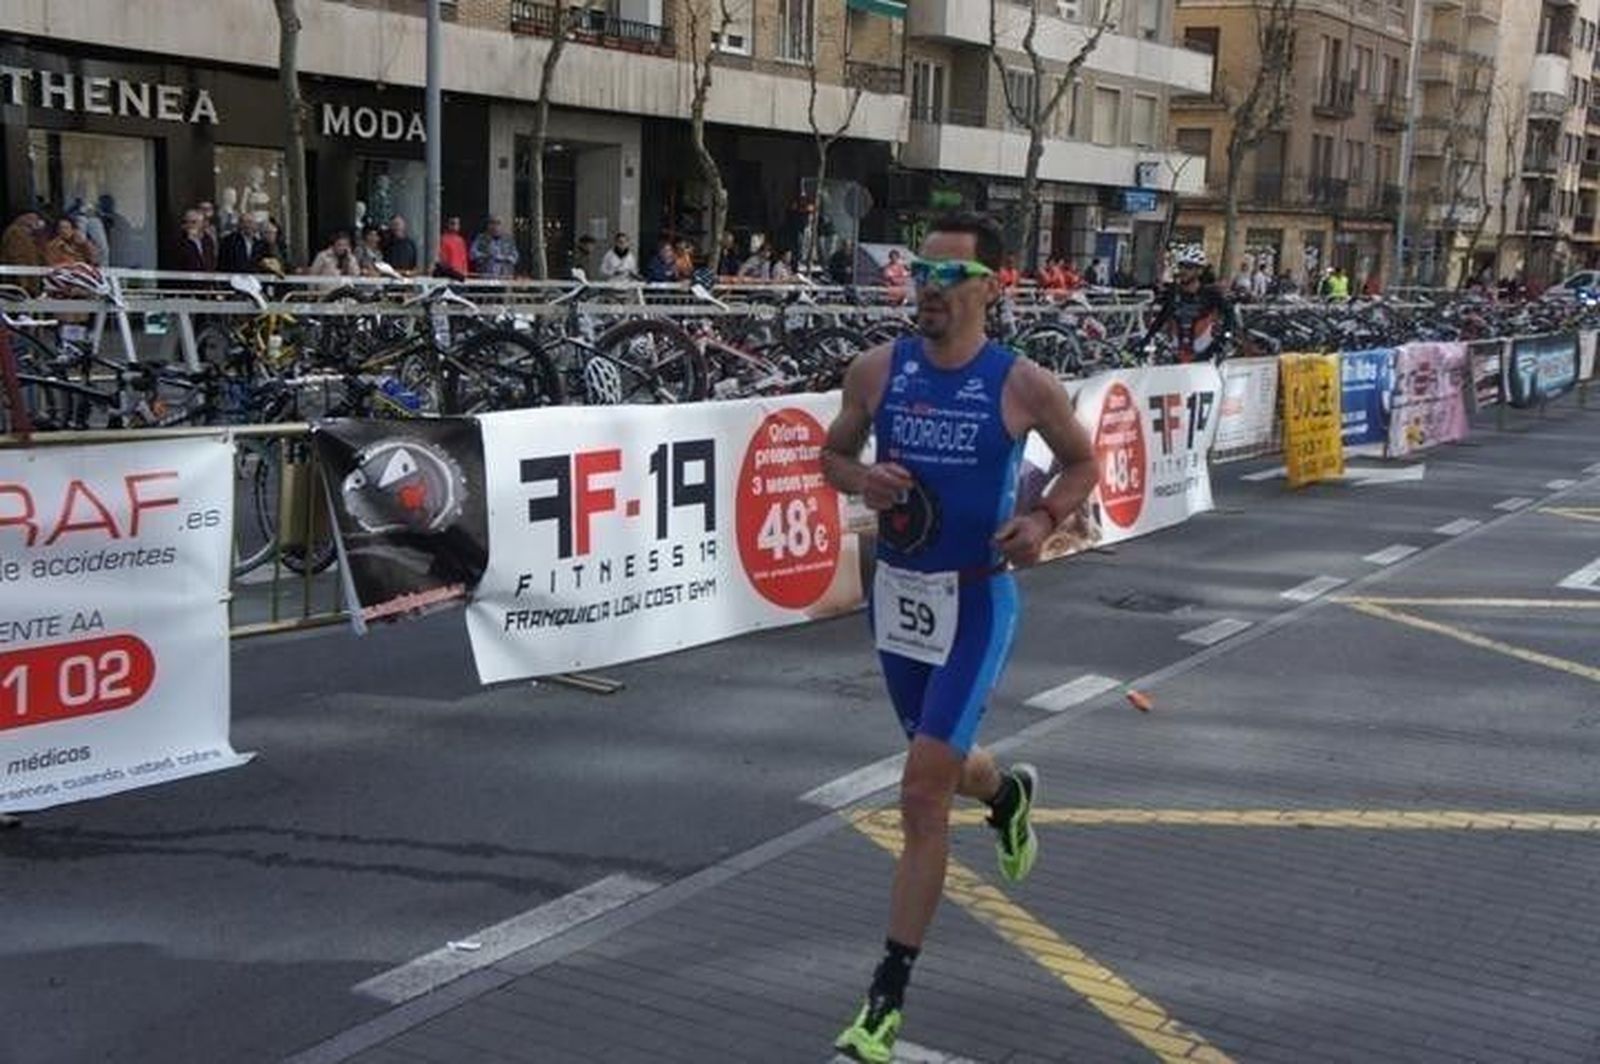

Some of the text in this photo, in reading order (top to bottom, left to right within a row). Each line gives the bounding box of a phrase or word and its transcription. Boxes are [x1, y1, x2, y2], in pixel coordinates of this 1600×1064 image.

[0, 66, 220, 125] THENEA
[322, 103, 427, 142] MODA
[893, 414, 979, 451] RODRIGUEZ
[752, 476, 762, 495] 3
[32, 547, 176, 578] accidentes
[515, 545, 684, 598] FITNESS
[69, 609, 104, 633] AA
[504, 600, 610, 632] FRANQUICIA
[645, 585, 685, 608] COST
[689, 579, 716, 601] GYM
[898, 595, 936, 637] 59
[58, 650, 133, 707] 02
[7, 745, 91, 775] médicos
